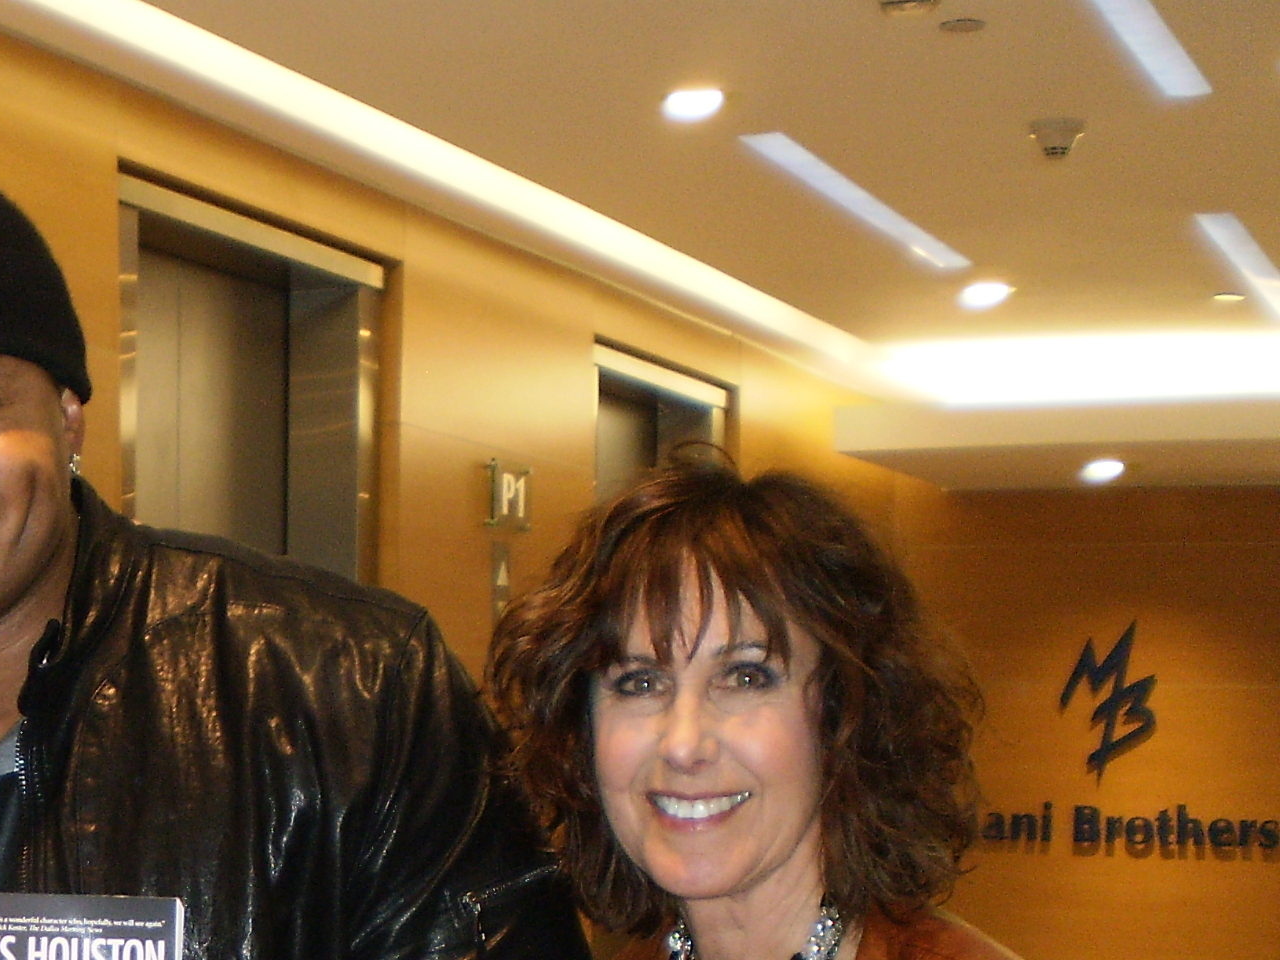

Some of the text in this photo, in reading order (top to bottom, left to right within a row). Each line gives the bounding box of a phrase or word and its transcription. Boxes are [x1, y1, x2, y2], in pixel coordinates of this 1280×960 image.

[501, 472, 526, 518] P1
[982, 801, 1280, 849] ani Brothers
[9, 916, 39, 924] wonderful
[60, 925, 85, 933] Morning
